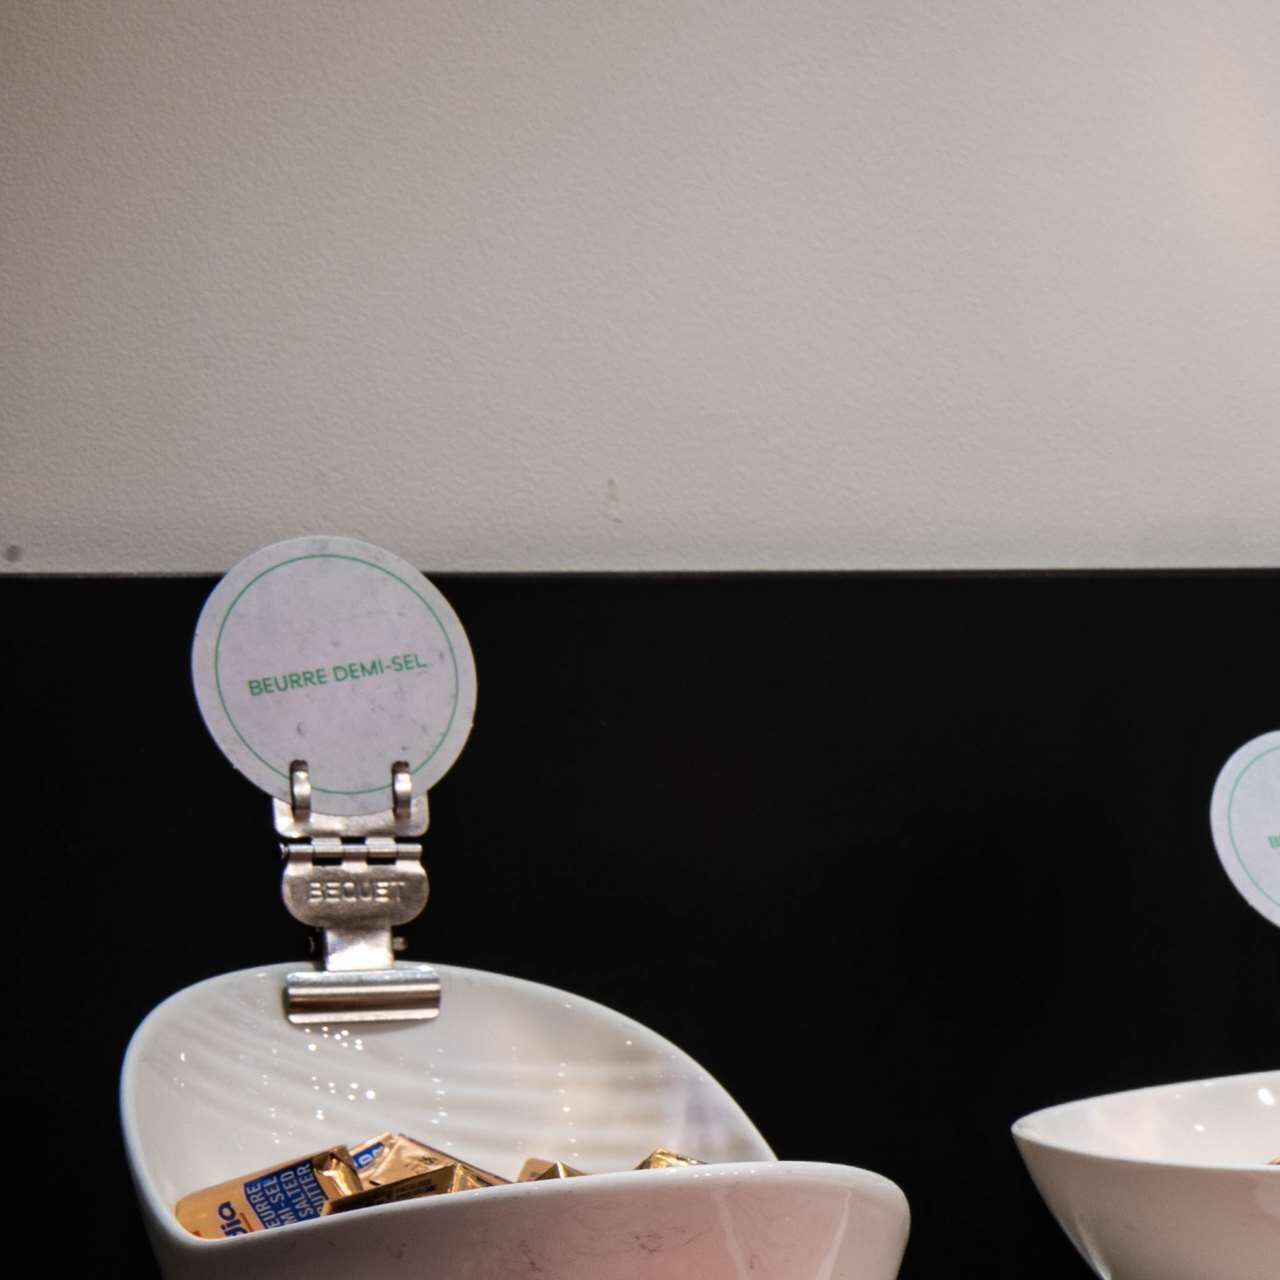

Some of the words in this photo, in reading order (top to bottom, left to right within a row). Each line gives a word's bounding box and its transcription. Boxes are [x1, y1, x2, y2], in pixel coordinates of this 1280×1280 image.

[248, 668, 328, 697] BEURRE
[332, 652, 429, 683] DEMI-SEL
[279, 1169, 315, 1219] SALTED
